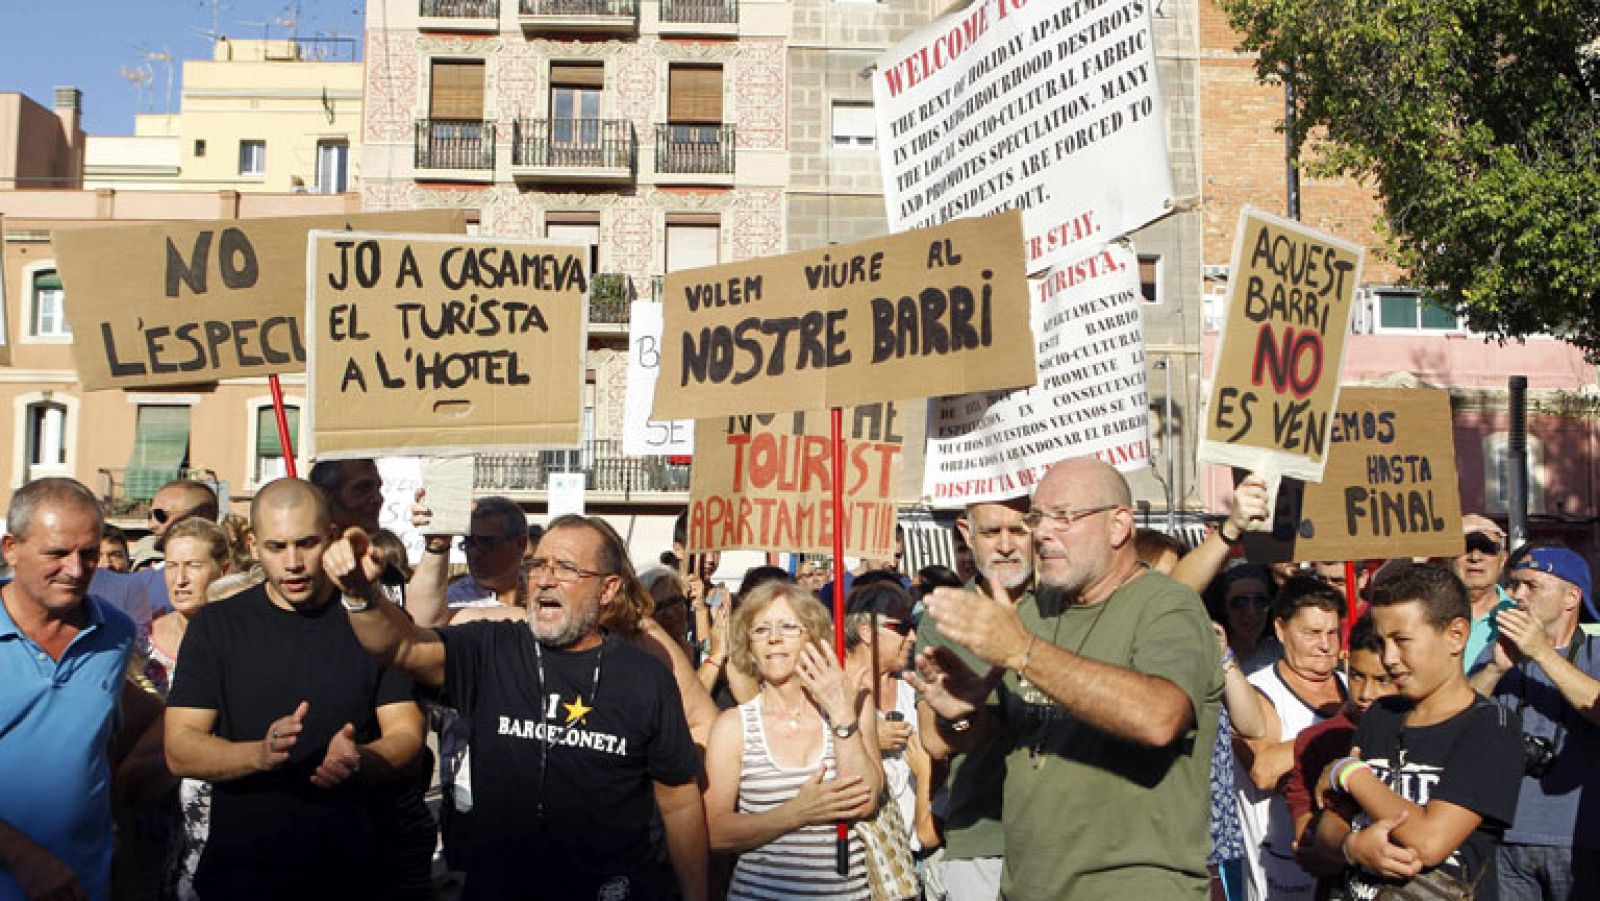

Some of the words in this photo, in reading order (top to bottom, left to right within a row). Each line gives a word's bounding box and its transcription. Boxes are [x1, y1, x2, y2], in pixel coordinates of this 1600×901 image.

[885, 0, 990, 98] WELCOME
[890, 110, 917, 138] THE
[919, 87, 951, 122] RENT
[967, 31, 1024, 87] HOLIDAY
[893, 144, 907, 166] IN
[911, 124, 940, 155] THIS
[942, 48, 1053, 136] NEIGHBOURHOOD
[1057, 0, 1144, 61] DESTROYS
[897, 164, 921, 192] THE
[957, 67, 1080, 153] SOCIO-CULTURAL
[1082, 27, 1147, 80] FABRIC
[899, 193, 924, 221] AND
[925, 151, 986, 205] PROMOTES
[988, 92, 1098, 164] SPECULATION.
[1099, 60, 1149, 104] MANY
[940, 166, 1014, 224] RESIDENTS
[1019, 147, 1051, 181] ARE
[1054, 110, 1124, 161] FORCED
[1127, 95, 1153, 122] TO
[165, 227, 259, 297] NO
[1047, 209, 1102, 253] STAY.
[1252, 226, 1355, 300] AQUEST
[328, 240, 381, 290] JO
[395, 245, 423, 288] A
[685, 275, 762, 311] VOLEM
[927, 239, 962, 269] AL
[329, 304, 370, 341] EL
[1246, 276, 1329, 335] BARRI
[341, 357, 367, 392] A
[375, 347, 531, 389] L'HOTEL
[681, 308, 852, 387] NOSTRE
[1043, 358, 1119, 391] PROMUEVE
[1252, 322, 1324, 399] NO
[1049, 402, 1108, 429] VECINOS
[1084, 427, 1101, 441] EL
[1215, 387, 1258, 442] ES
[1273, 398, 1328, 456] VEN
[935, 473, 1016, 498] DISFRUTA
[1367, 454, 1432, 484] HASTA
[498, 715, 627, 756] BARCELONETA
[546, 693, 561, 718] I
